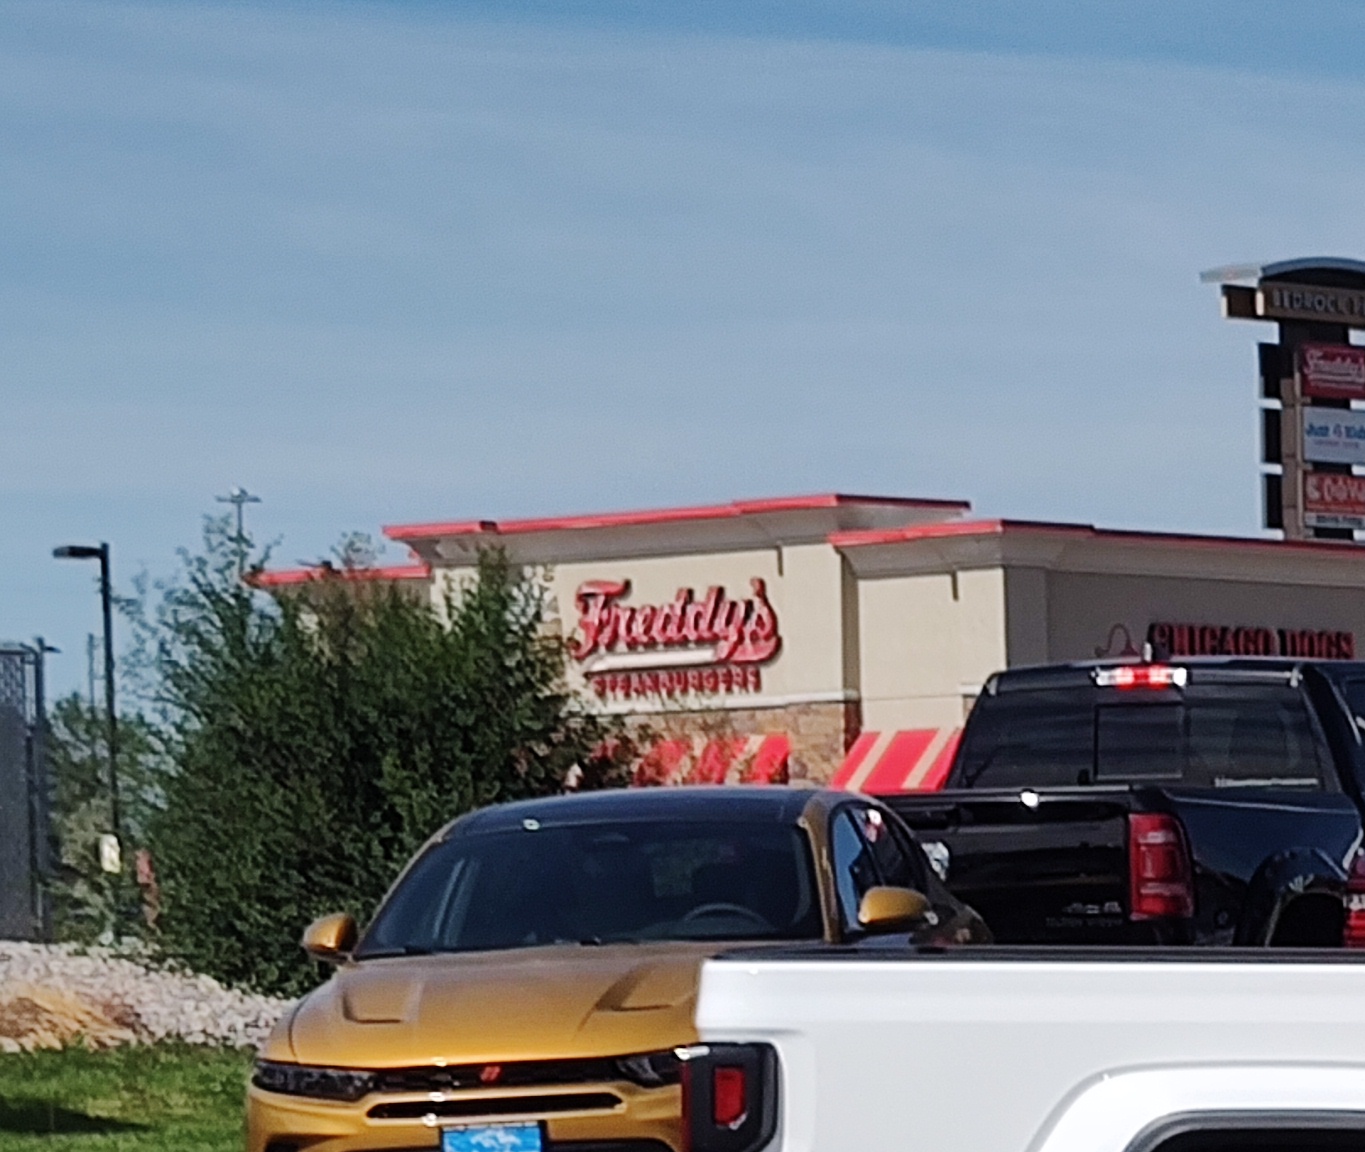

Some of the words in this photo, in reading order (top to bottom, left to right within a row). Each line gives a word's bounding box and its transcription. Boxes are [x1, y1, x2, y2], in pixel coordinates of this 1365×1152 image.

[570, 577, 783, 663] Freddy's
[1149, 623, 1276, 656] CHICAGO
[1280, 629, 1355, 660] DOGS
